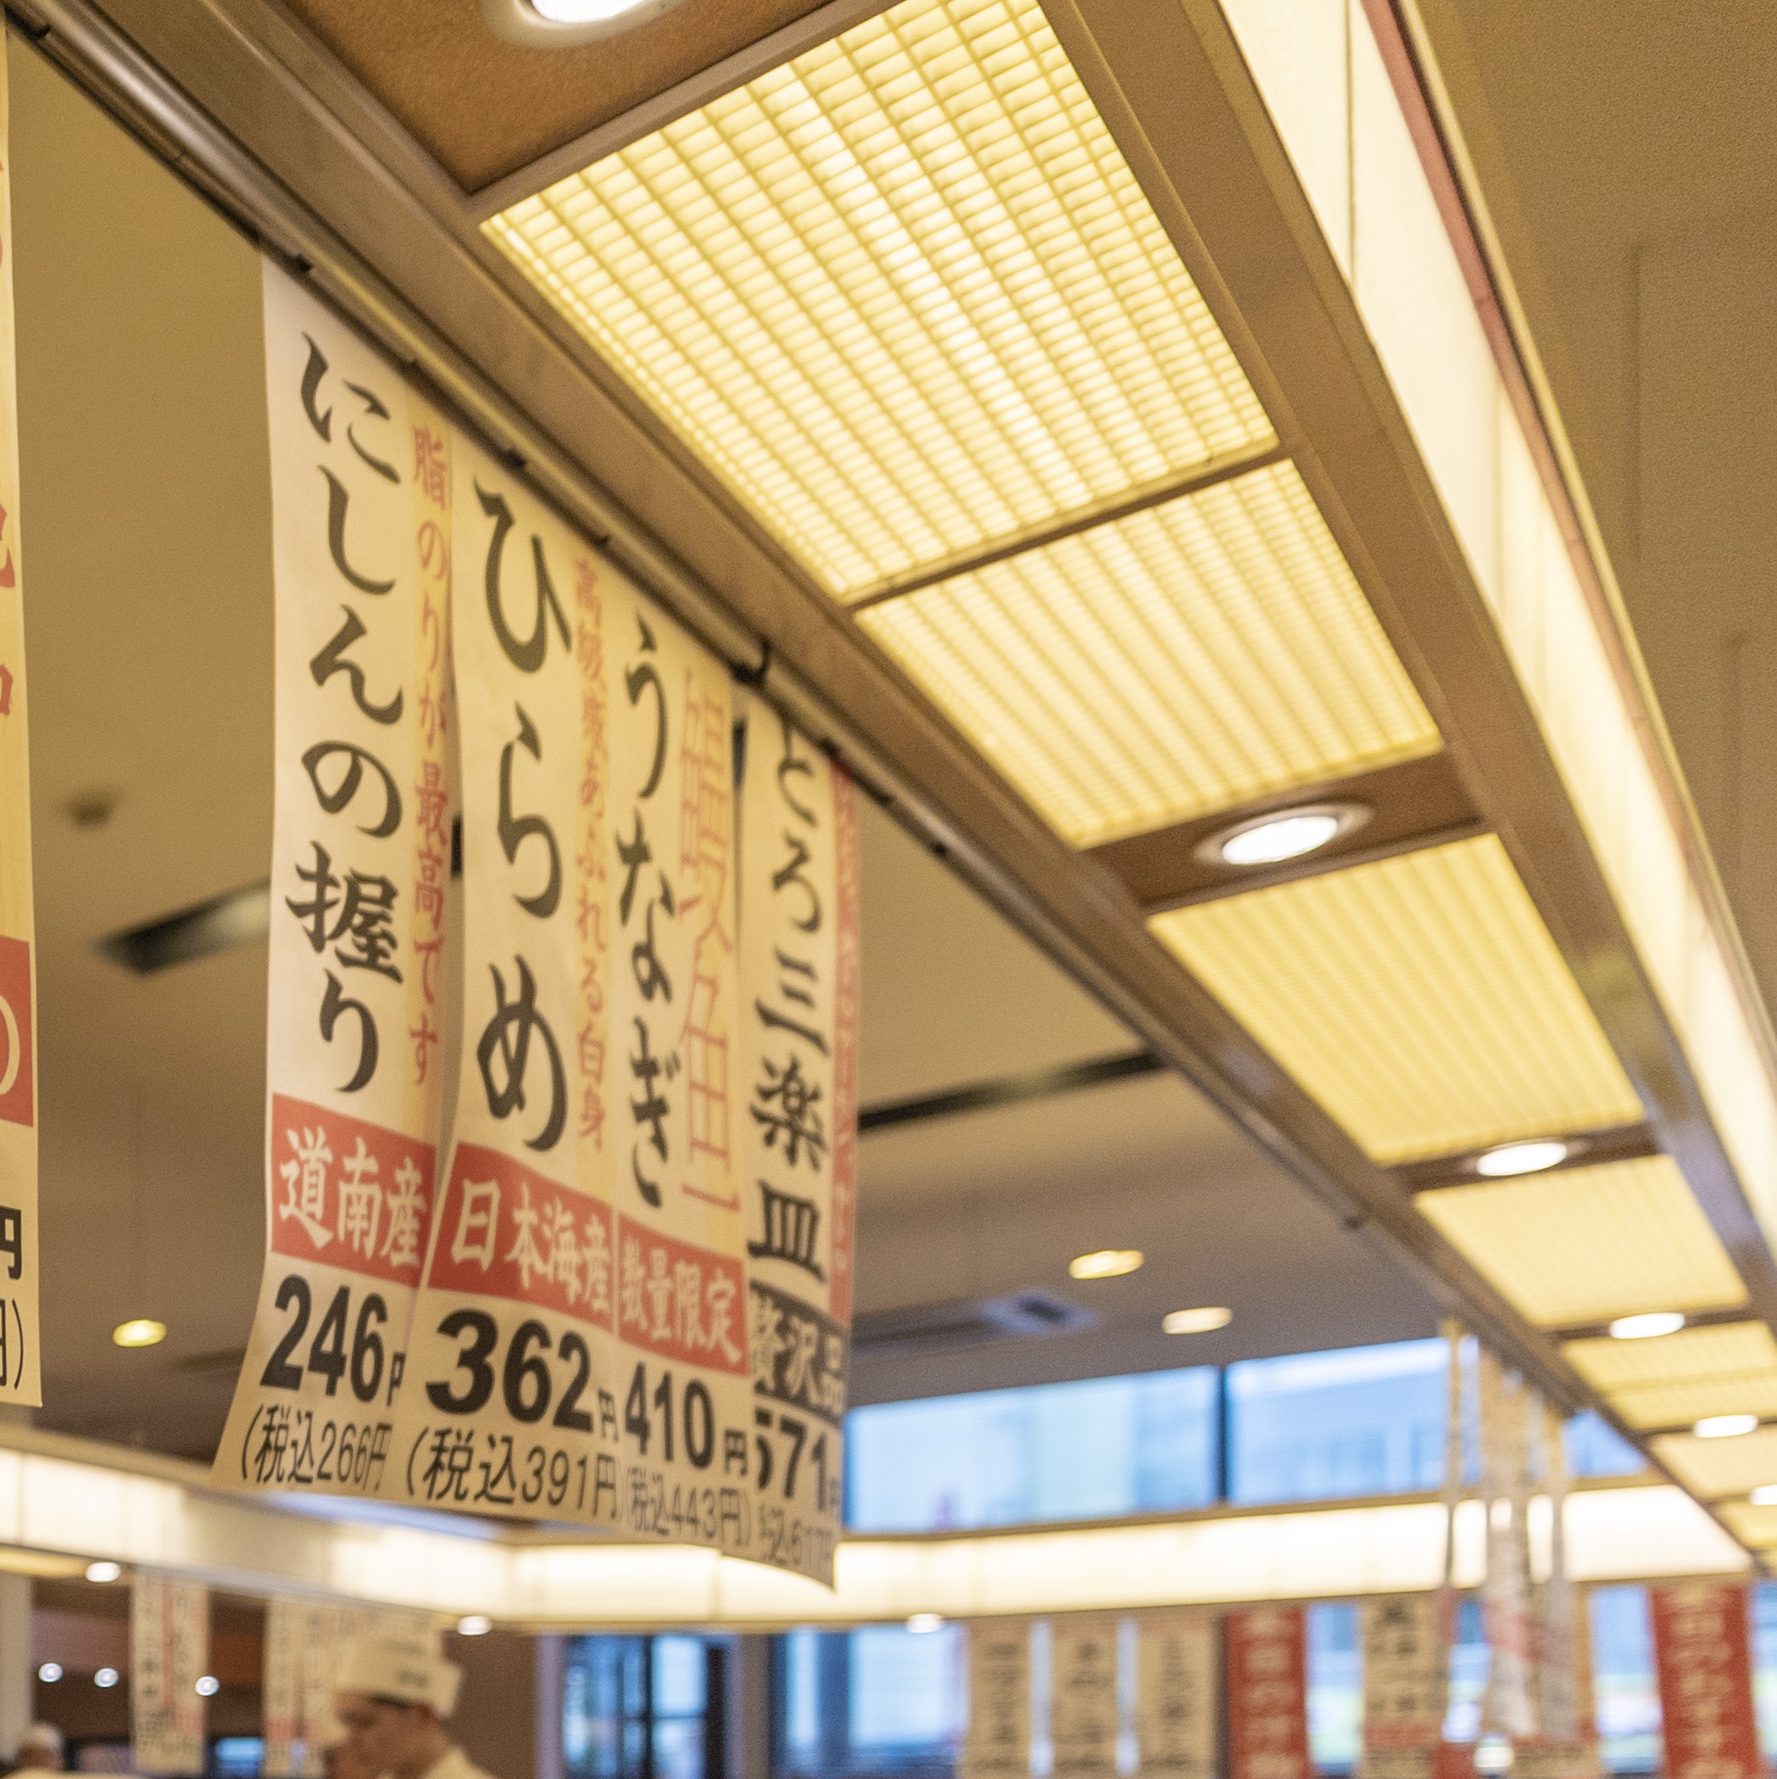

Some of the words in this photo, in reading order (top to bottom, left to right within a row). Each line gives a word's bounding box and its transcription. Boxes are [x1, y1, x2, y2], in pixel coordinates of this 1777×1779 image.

[283, 330, 406, 1095] にしんの握り
[473, 472, 573, 1155] ひらめ
[615, 610, 682, 1209] うなぎ
[280, 1127, 428, 1270] 道南産
[452, 1179, 612, 1319] 日本海産
[425, 1309, 621, 1445] 362円
[623, 1361, 749, 1477] 410円
